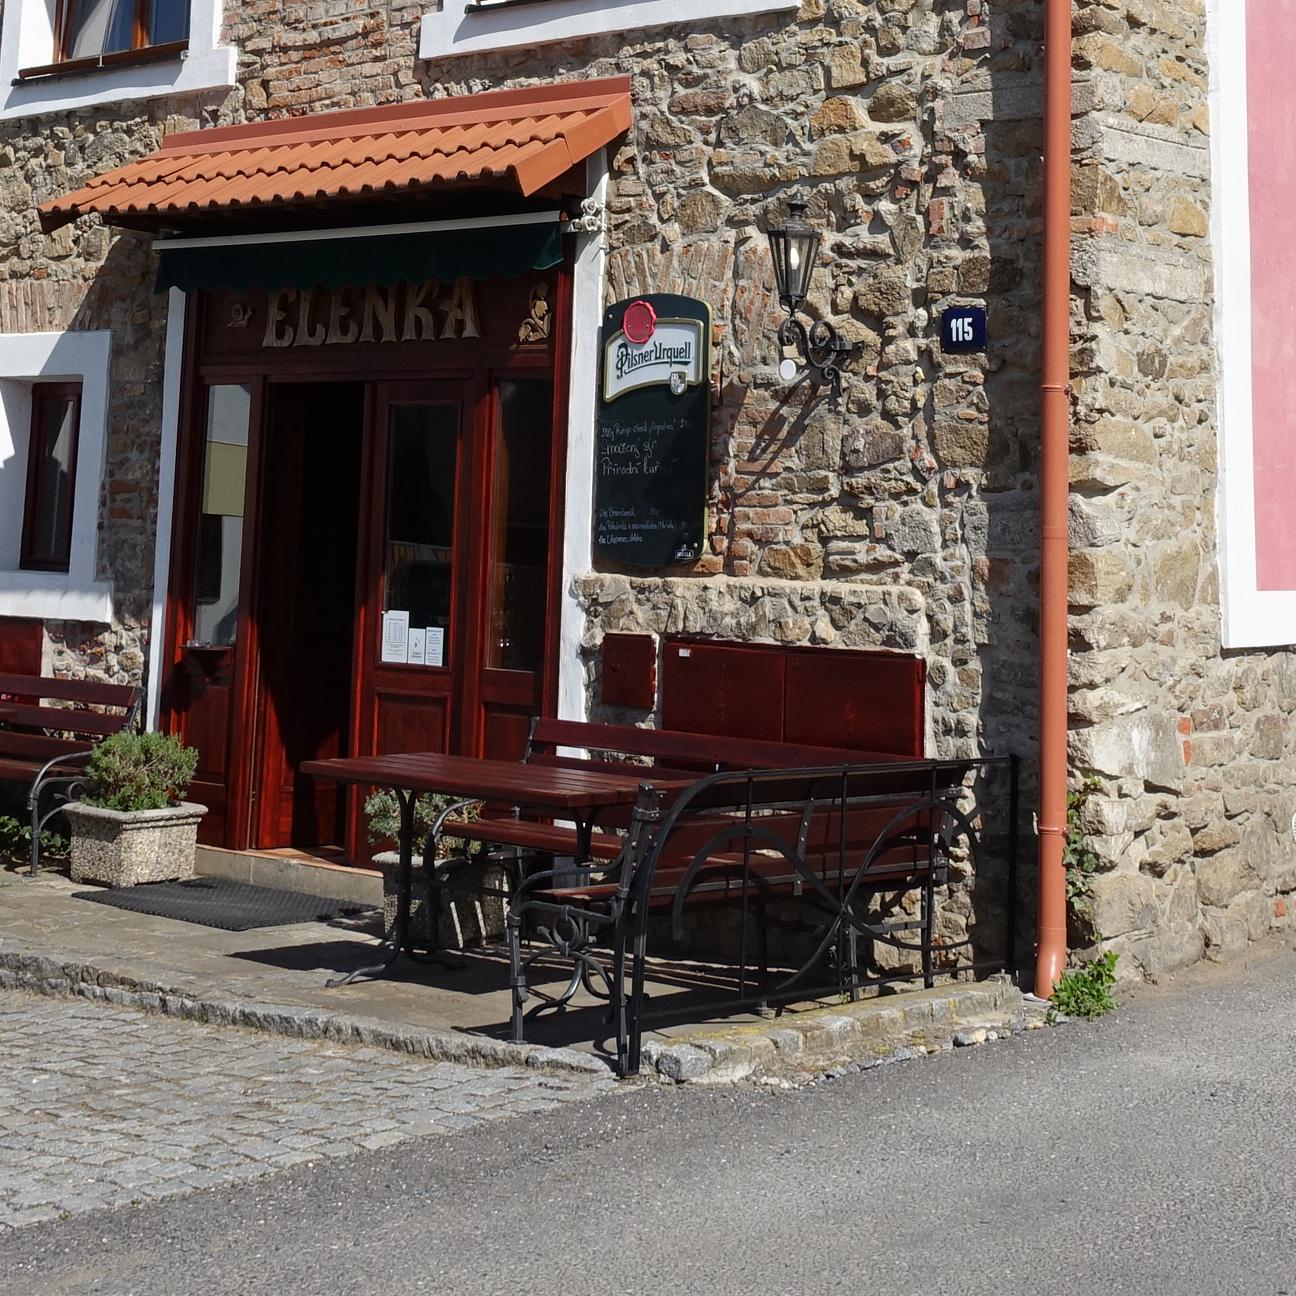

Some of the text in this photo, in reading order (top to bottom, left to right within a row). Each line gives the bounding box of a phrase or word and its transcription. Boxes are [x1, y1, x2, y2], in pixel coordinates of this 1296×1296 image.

[262, 277, 480, 347] ELENKA
[950, 317, 974, 342] 115
[616, 341, 691, 380] Pilsner Urquell
